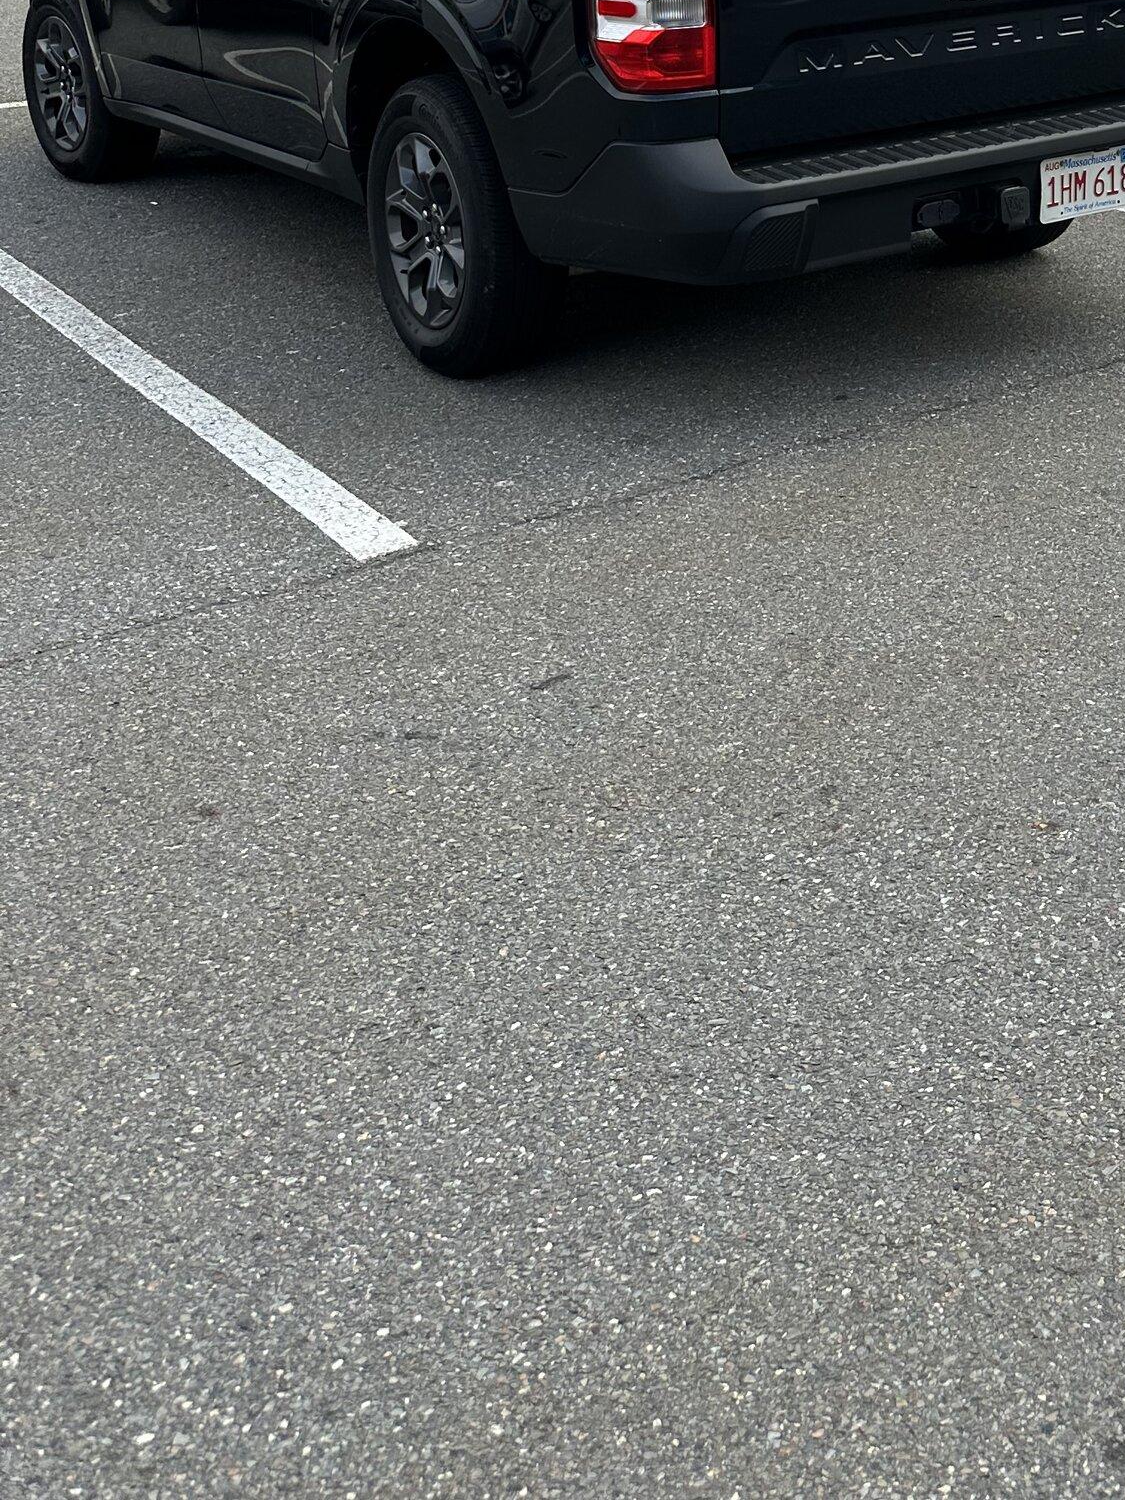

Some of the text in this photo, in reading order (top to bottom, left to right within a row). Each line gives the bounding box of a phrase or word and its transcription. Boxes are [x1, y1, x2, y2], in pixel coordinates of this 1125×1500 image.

[798, 8, 1125, 74] MAVERICK
[1045, 161, 1060, 172] AUG
[1063, 153, 1117, 169] Massachusetts
[1047, 170, 1087, 208] 1HM
[1073, 202, 1088, 212] Spirit
[1088, 201, 1095, 210] of
[1095, 199, 1117, 208] America
